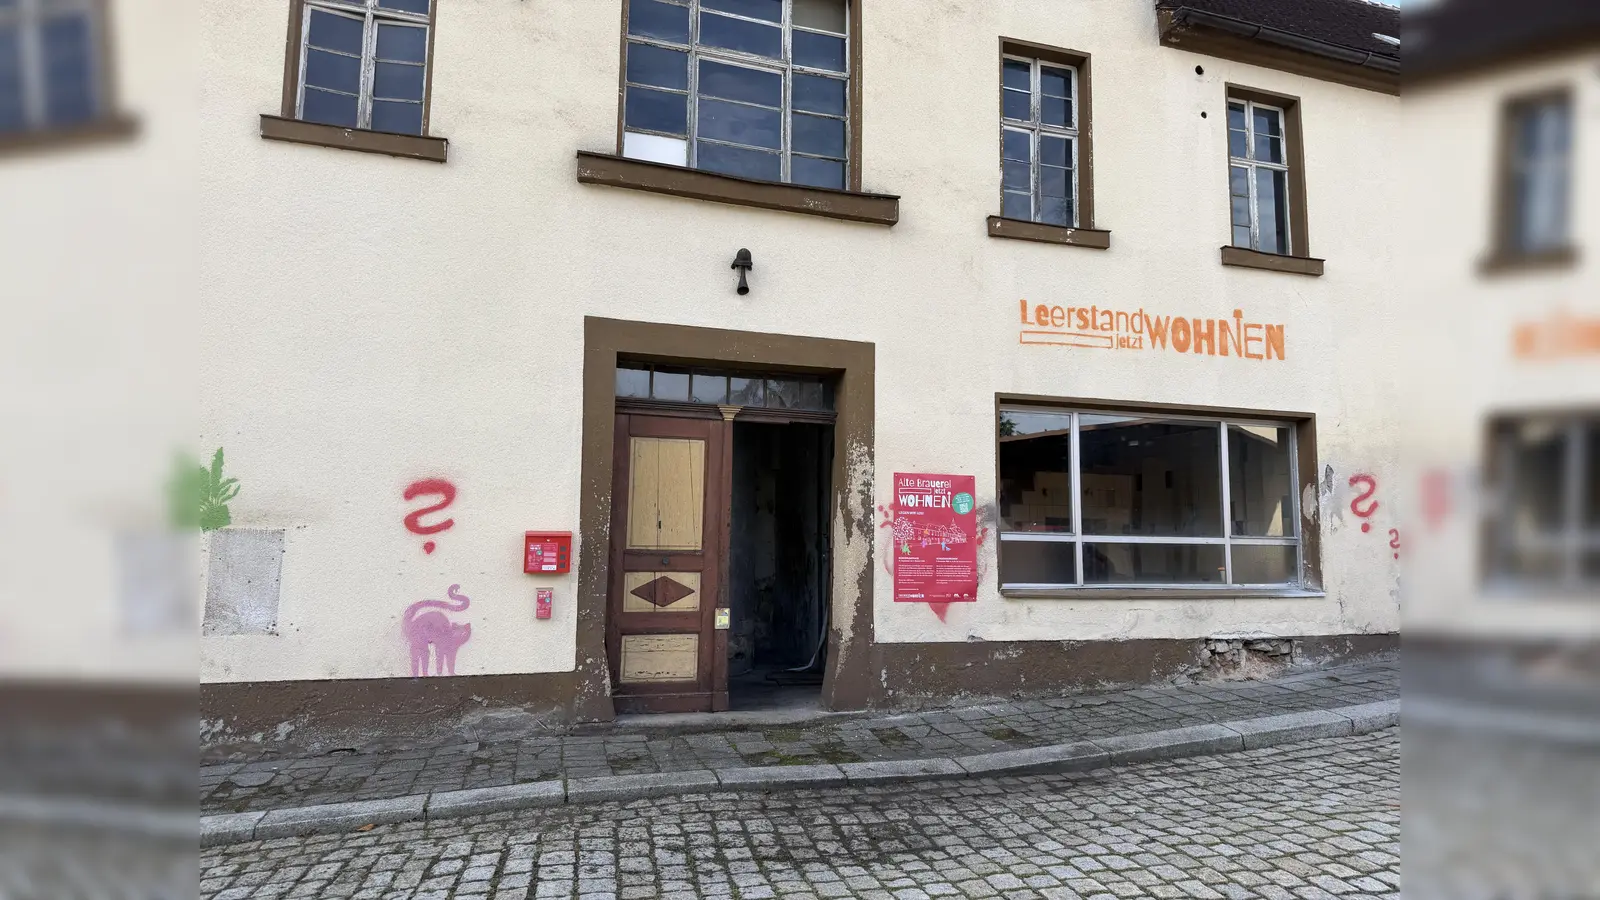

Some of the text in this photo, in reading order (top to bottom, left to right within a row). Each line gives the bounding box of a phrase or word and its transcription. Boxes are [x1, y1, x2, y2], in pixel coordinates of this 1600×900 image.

[1020, 299, 1285, 361] Leerstand WOHNEN
[1114, 335, 1144, 350] jetzt
[898, 477, 952, 488] Alte Brauerei
[898, 491, 951, 508] WOHNEN
